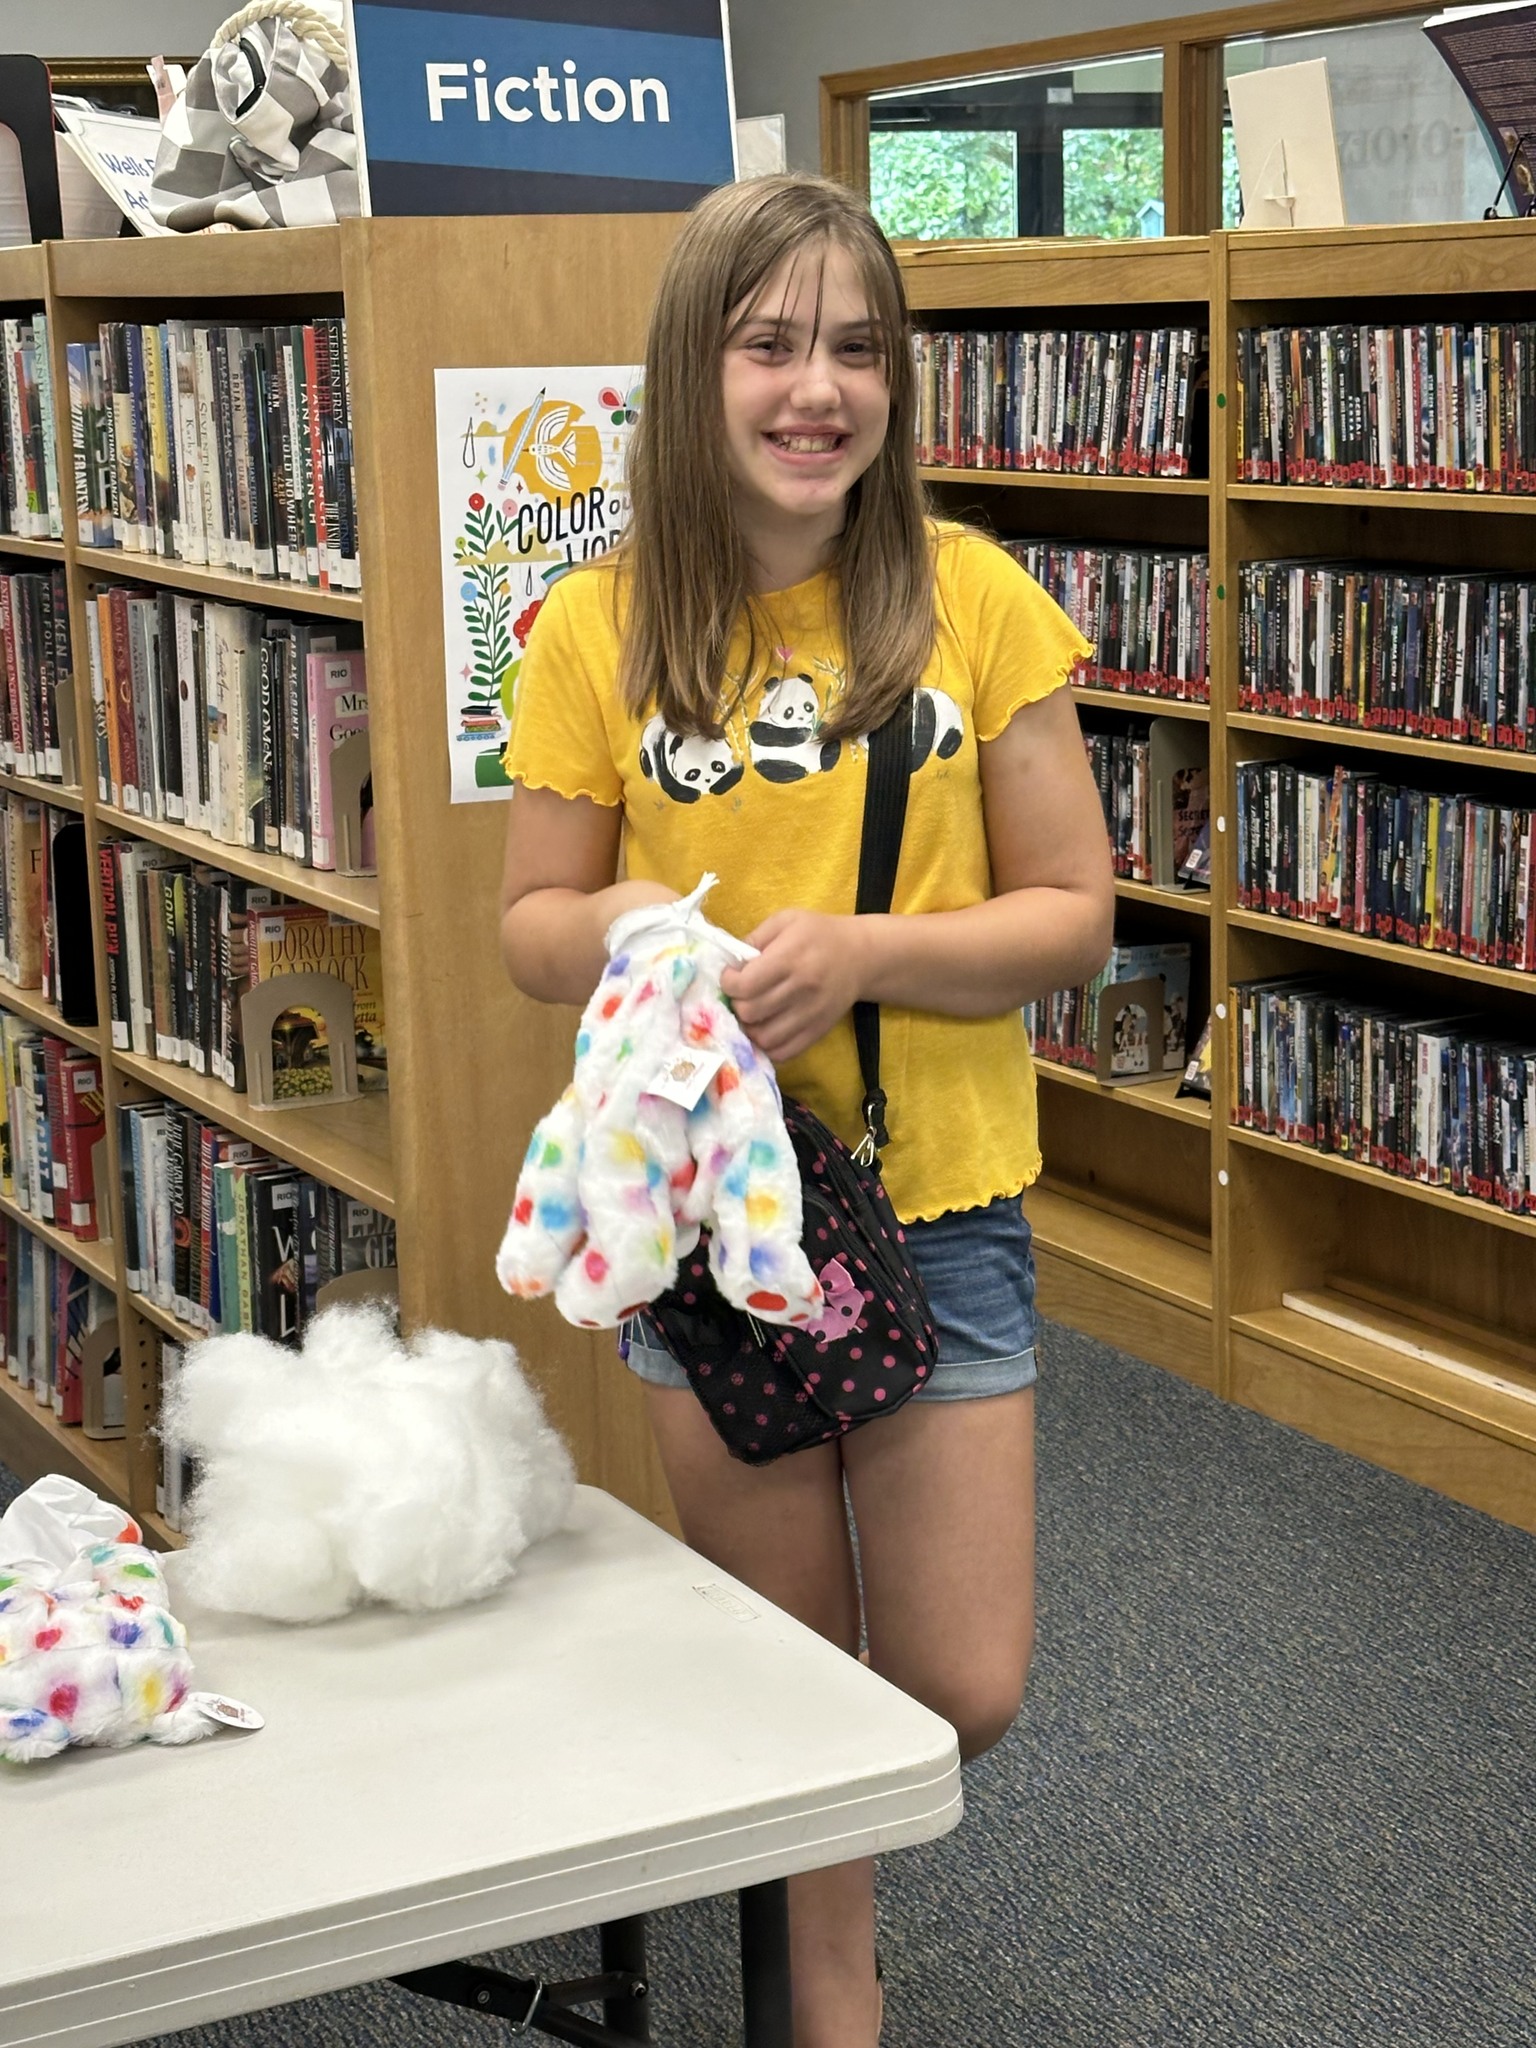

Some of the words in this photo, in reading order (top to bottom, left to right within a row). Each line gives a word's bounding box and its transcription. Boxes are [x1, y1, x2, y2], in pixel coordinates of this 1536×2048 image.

[426, 58, 670, 123] Fiction
[97, 152, 150, 177] Wells
[327, 325, 340, 387] STEPHEN
[232, 373, 241, 412] BRIAN
[271, 375, 280, 408] BRIAN
[330, 392, 344, 425] FREY
[106, 406, 117, 460] JONATHAN
[75, 454, 88, 515] FRANZEN
[200, 402, 209, 474] SEVENTH
[205, 481, 214, 529] STONE
[110, 465, 119, 515] FRANZEN
[305, 448, 317, 525] FRENCH
[285, 478, 298, 552] NOWHERE
[324, 502, 338, 519] THE
[338, 501, 351, 554] PARTNER
[518, 487, 606, 554] COLOR
[41, 582, 50, 614] KEN
[55, 618, 68, 656] KEN
[1137, 597, 1146, 648] RESPECT
[44, 620, 55, 688] FOLLETT
[331, 668, 348, 678] RIO
[1455, 648, 1464, 679] TILL
[262, 648, 271, 704] GOOD
[291, 691, 299, 740] COUNTY
[99, 847, 116, 917] VERTICAL
[142, 858, 158, 869] RIO
[1356, 853, 1364, 883] VOW
[164, 886, 175, 938] GONE
[251, 895, 268, 904] RIO
[264, 925, 281, 934] RIO
[270, 925, 368, 963] DOROTHY
[77, 1078, 91, 1086] RIO
[232, 1150, 249, 1159] RIO
[276, 1192, 293, 1201] RIO
[352, 1208, 369, 1217] RIO
[238, 1194, 248, 1281] JONATHAN
